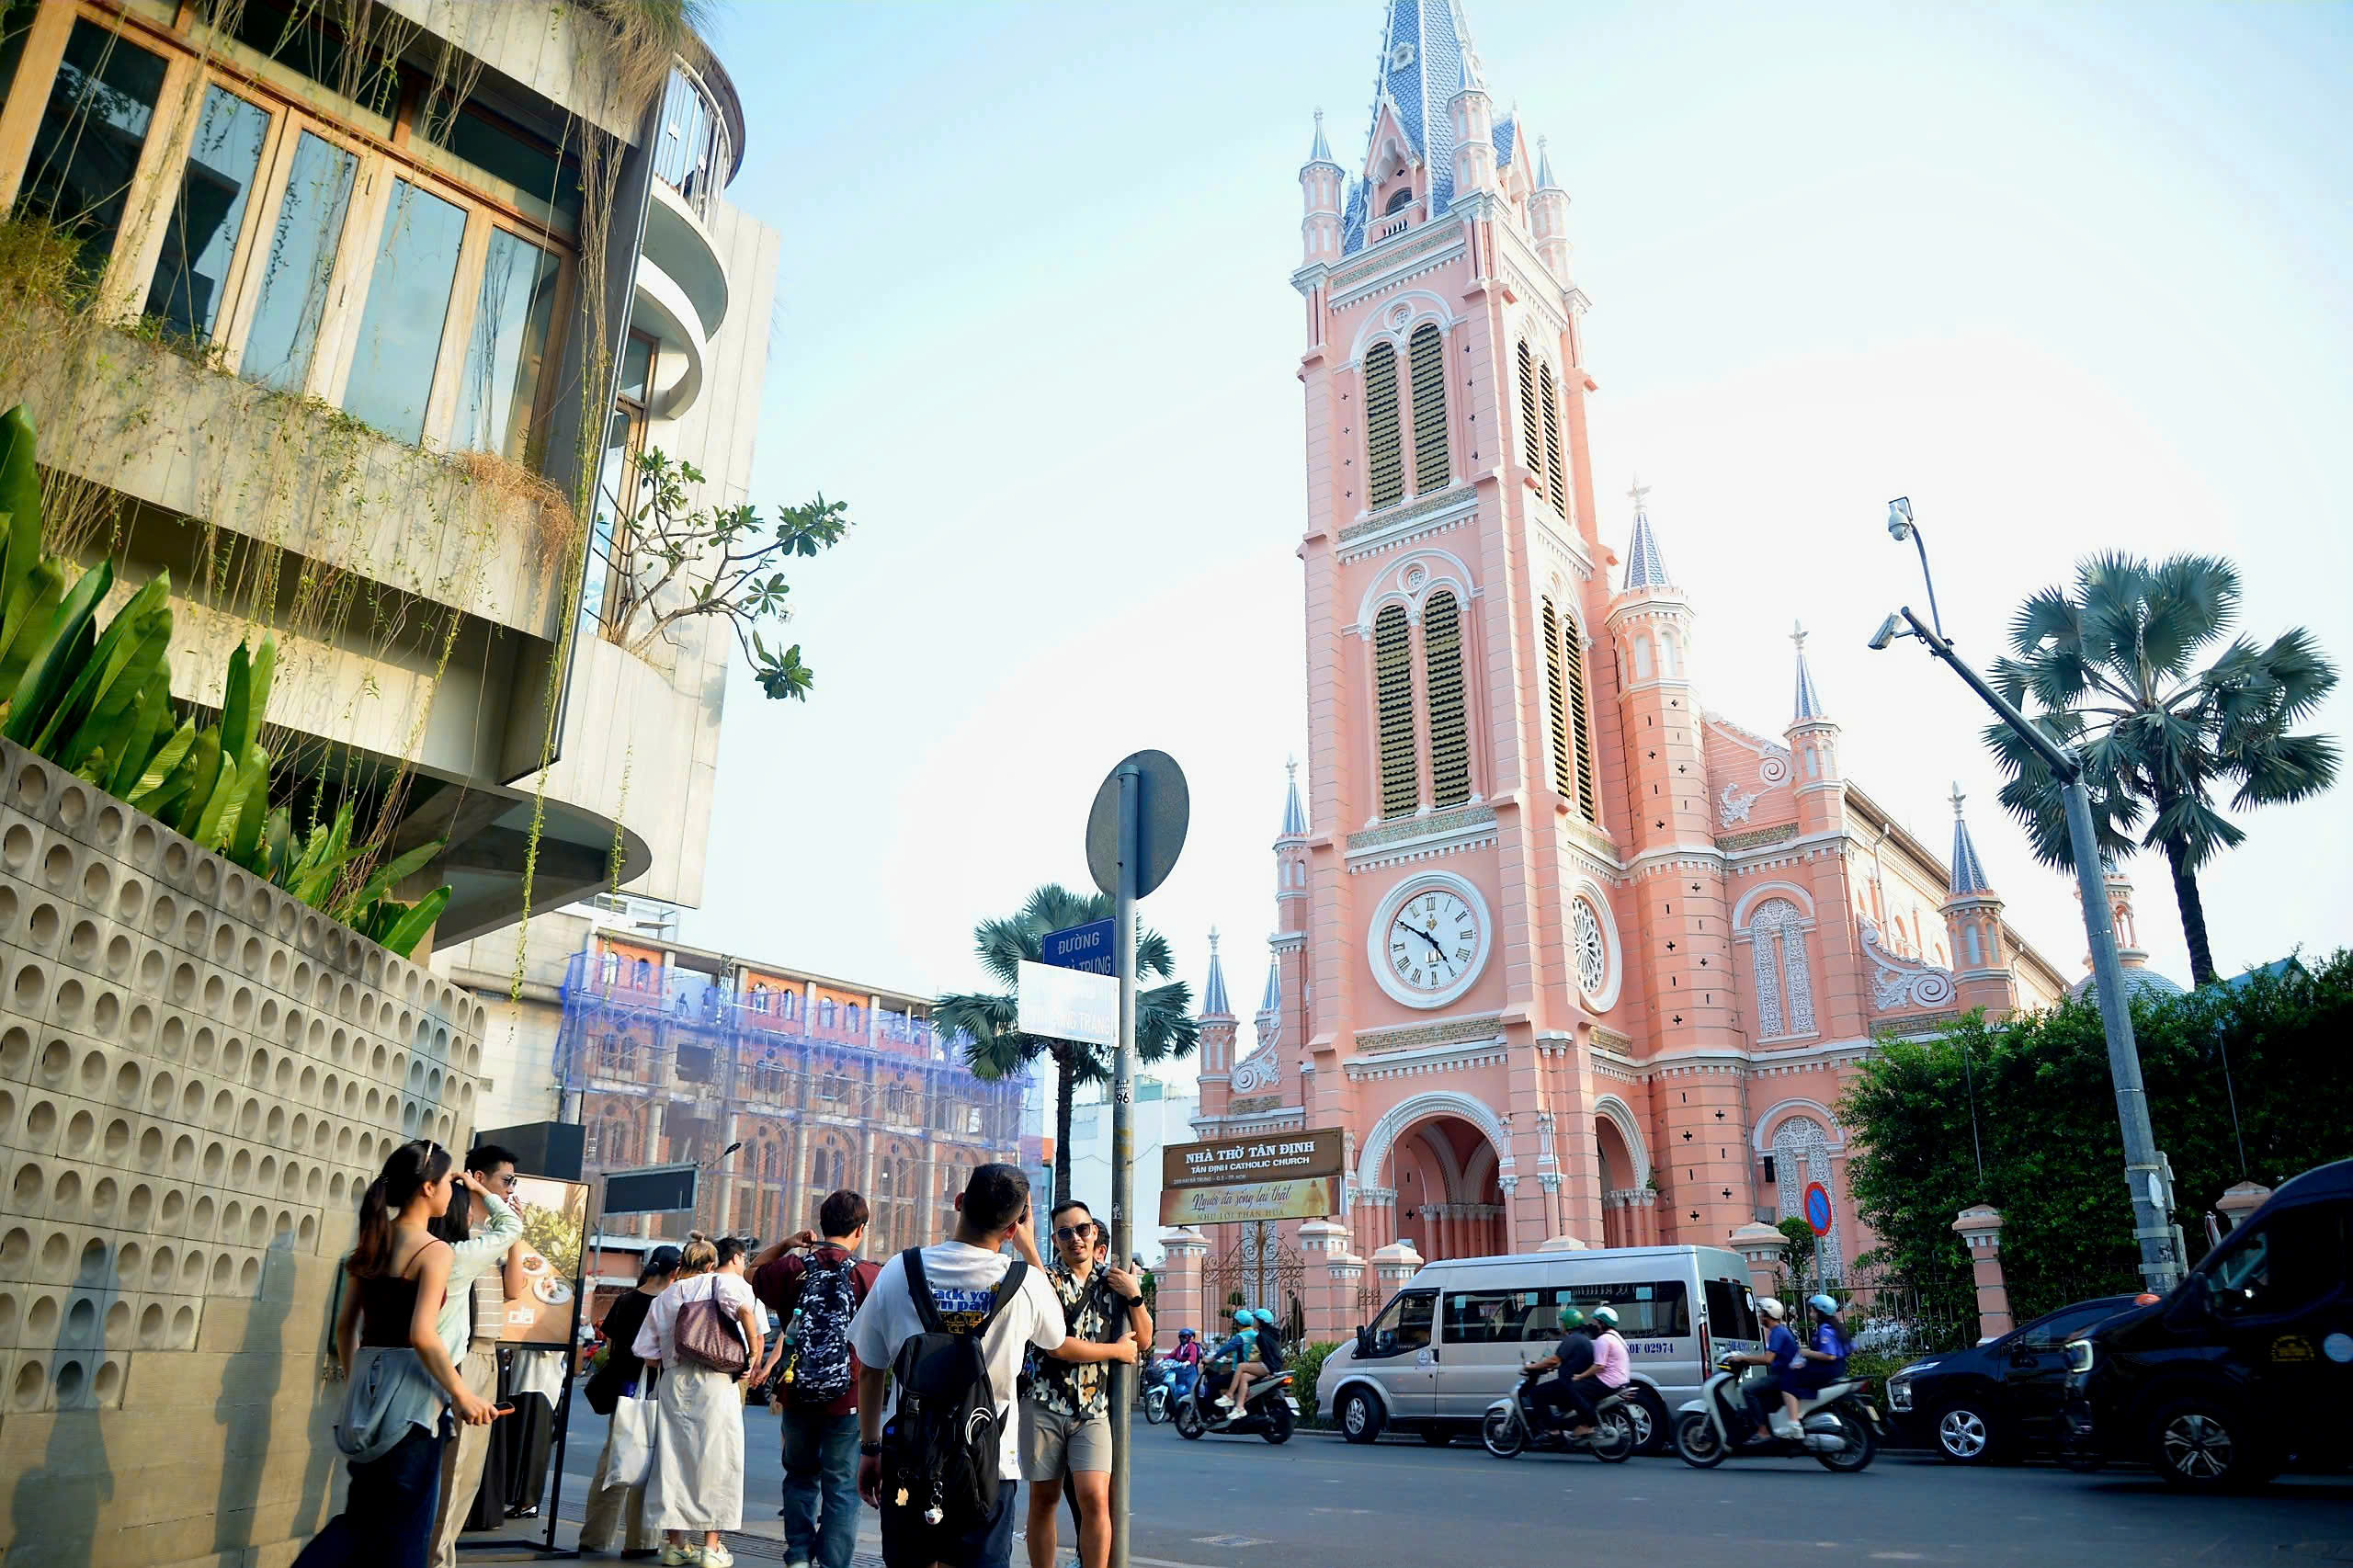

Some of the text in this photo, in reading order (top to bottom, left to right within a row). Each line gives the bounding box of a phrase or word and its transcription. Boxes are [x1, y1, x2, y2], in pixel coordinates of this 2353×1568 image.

[1057, 931, 1100, 955] ĐƯỜNG
[1116, 1093, 1130, 1104] 96
[1185, 1141, 1315, 1164] NHÀ THỜ TÂN ĐỊNH
[1191, 1156, 1310, 1174] TÂN ĐỊNH CATHOLIC CHURCH
[1221, 1190, 1233, 1205] đã
[1235, 1187, 1253, 1209] sống
[1256, 1186, 1270, 1206] lại
[1271, 1184, 1293, 1204] thật
[934, 1289, 965, 1301] ack
[1628, 1343, 1674, 1353] 0F 02974
